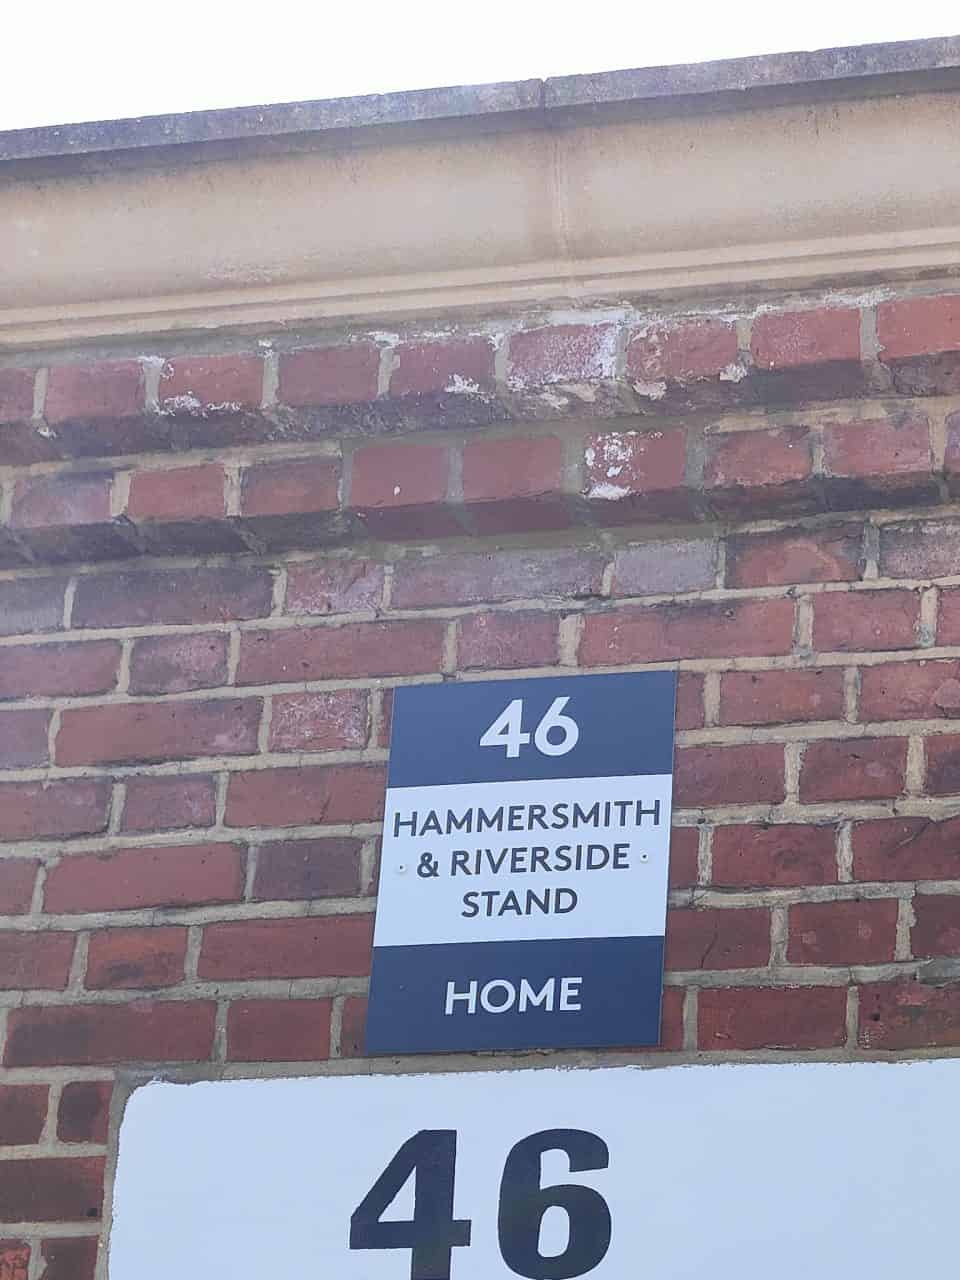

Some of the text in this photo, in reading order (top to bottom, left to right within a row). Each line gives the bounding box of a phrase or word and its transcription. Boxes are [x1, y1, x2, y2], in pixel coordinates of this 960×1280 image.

[479, 696, 579, 758] 46
[393, 799, 661, 838] HAMMERSMITH
[417, 843, 631, 878] & RIVERSIDE
[461, 887, 578, 918] STAND
[445, 976, 583, 1015] HOME
